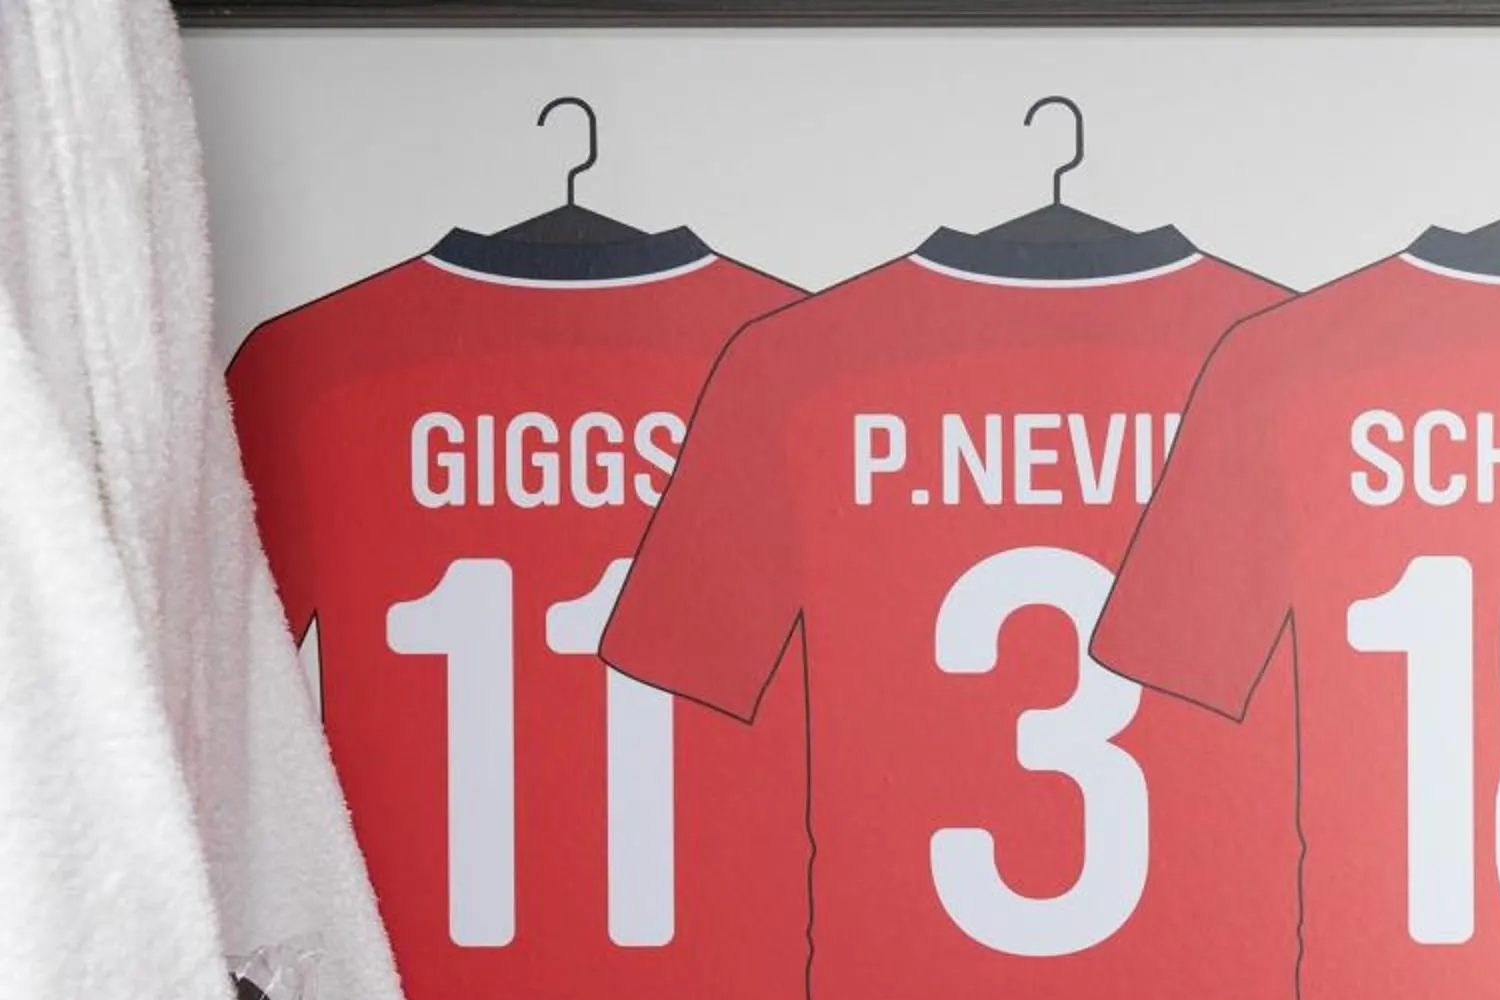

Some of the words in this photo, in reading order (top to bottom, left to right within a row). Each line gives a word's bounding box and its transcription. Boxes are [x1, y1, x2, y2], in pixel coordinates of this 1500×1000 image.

[411, 411, 686, 509] GIGGS
[854, 413, 1181, 505] P.NEVI
[387, 557, 675, 948] 11
[929, 545, 1150, 957] 3
